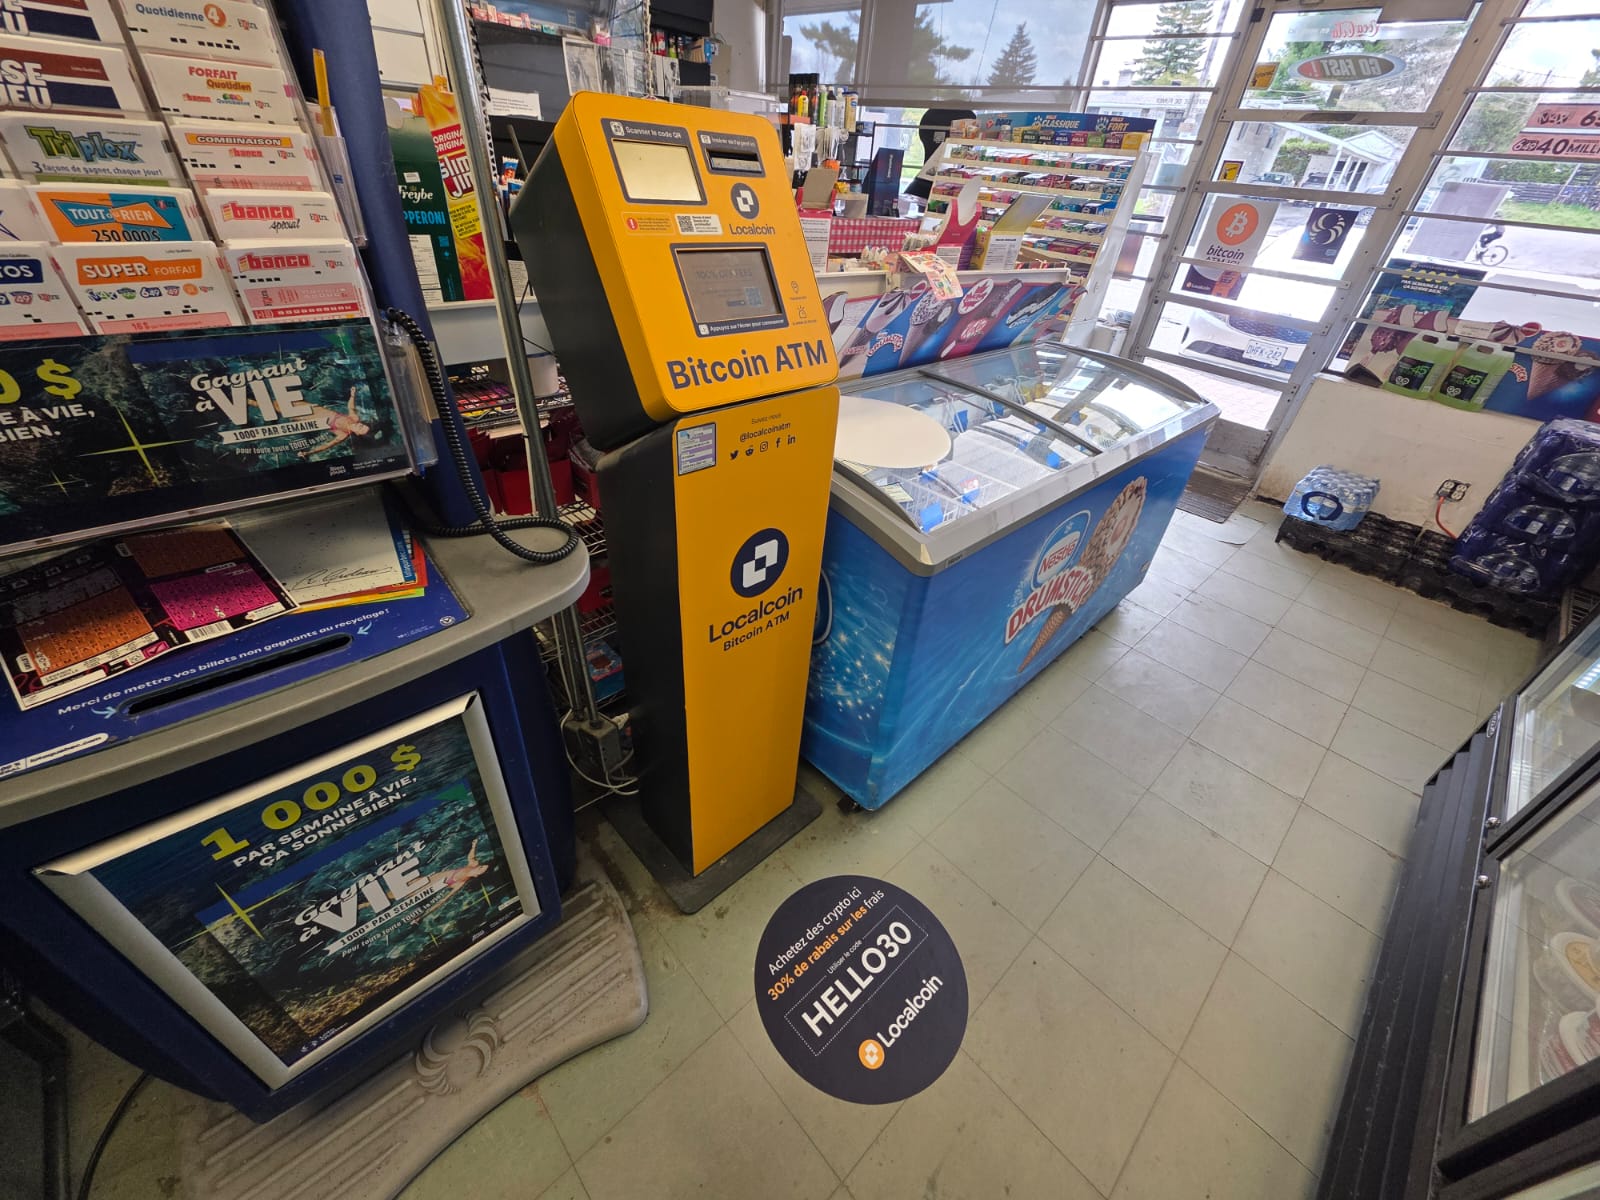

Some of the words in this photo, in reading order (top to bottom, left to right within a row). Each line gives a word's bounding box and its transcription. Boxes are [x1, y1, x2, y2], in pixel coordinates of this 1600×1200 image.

[136, 4, 204, 21] Quotidienne
[207, 7, 221, 24] 4
[188, 66, 238, 80] FORFAIT
[207, 79, 251, 92] Quotidien
[625, 126, 651, 136] Scanner
[658, 130, 672, 138] code
[672, 131, 682, 139] QR
[1041, 119, 1080, 130] CLASSIQUE
[1107, 121, 1129, 132] FORT
[24, 126, 144, 164] Triplex
[197, 136, 281, 146] COMBINAISON
[1536, 138, 1570, 155] 40
[32, 161, 43, 173] 3
[398, 185, 433, 203] Freybe
[68, 208, 104, 220] TOUT
[120, 209, 153, 222] RIEN
[222, 202, 296, 221] banco
[729, 223, 775, 236] Localcoin
[240, 252, 312, 272] banco
[1207, 245, 1244, 259] bitcoin
[82, 262, 149, 279] SUPER
[154, 265, 197, 275] FORFAIT
[667, 349, 769, 389] Bitcoin
[776, 339, 828, 371] ATM
[190, 358, 307, 392] Gagnant
[195, 397, 215, 412] à
[207, 374, 314, 426] VIE
[21, 406, 41, 422] À
[41, 403, 96, 420] VIE,
[262, 424, 280, 436] PAR
[282, 421, 319, 435] SEMAINE
[740, 422, 791, 442] @localcoinatm
[1006, 568, 1093, 641] DRUMSTICK
[709, 587, 803, 643] Localcoin
[723, 626, 763, 652] Bitcoin
[765, 611, 790, 631] ATM
[58, 697, 100, 715] Merci
[103, 691, 121, 702] de
[124, 676, 172, 695] mettre
[174, 668, 197, 678] vos
[199, 654, 237, 671] billets
[239, 647, 262, 659] non
[264, 631, 317, 652] gagnants
[319, 626, 333, 635] au
[334, 610, 385, 631] recyclage
[201, 827, 250, 861] 1
[261, 764, 377, 830] 000
[390, 744, 422, 771] $
[232, 842, 276, 867] PAR
[279, 797, 364, 845] SEMAINE
[368, 790, 381, 801] À
[382, 775, 417, 794] VIE,
[259, 850, 290, 867] ÇA
[291, 814, 358, 850] SONNE
[360, 792, 407, 817] BIEN.
[295, 840, 426, 926] Gagnant
[299, 927, 321, 942] à
[312, 856, 431, 933] VIE
[372, 913, 391, 927] PAR
[394, 887, 435, 914] SEMAINE
[768, 937, 809, 976] Achetez
[806, 922, 825, 941] des
[822, 897, 851, 926] crypto
[848, 886, 862, 901] ici
[767, 973, 795, 1001] 30%
[793, 961, 809, 978] de
[808, 931, 839, 965] rabais
[837, 919, 853, 936] sur
[850, 906, 868, 922] les
[863, 889, 885, 910] frais
[849, 939, 863, 954] code
[801, 921, 912, 1037] HELLO30
[876, 975, 944, 1048] Localcoin
